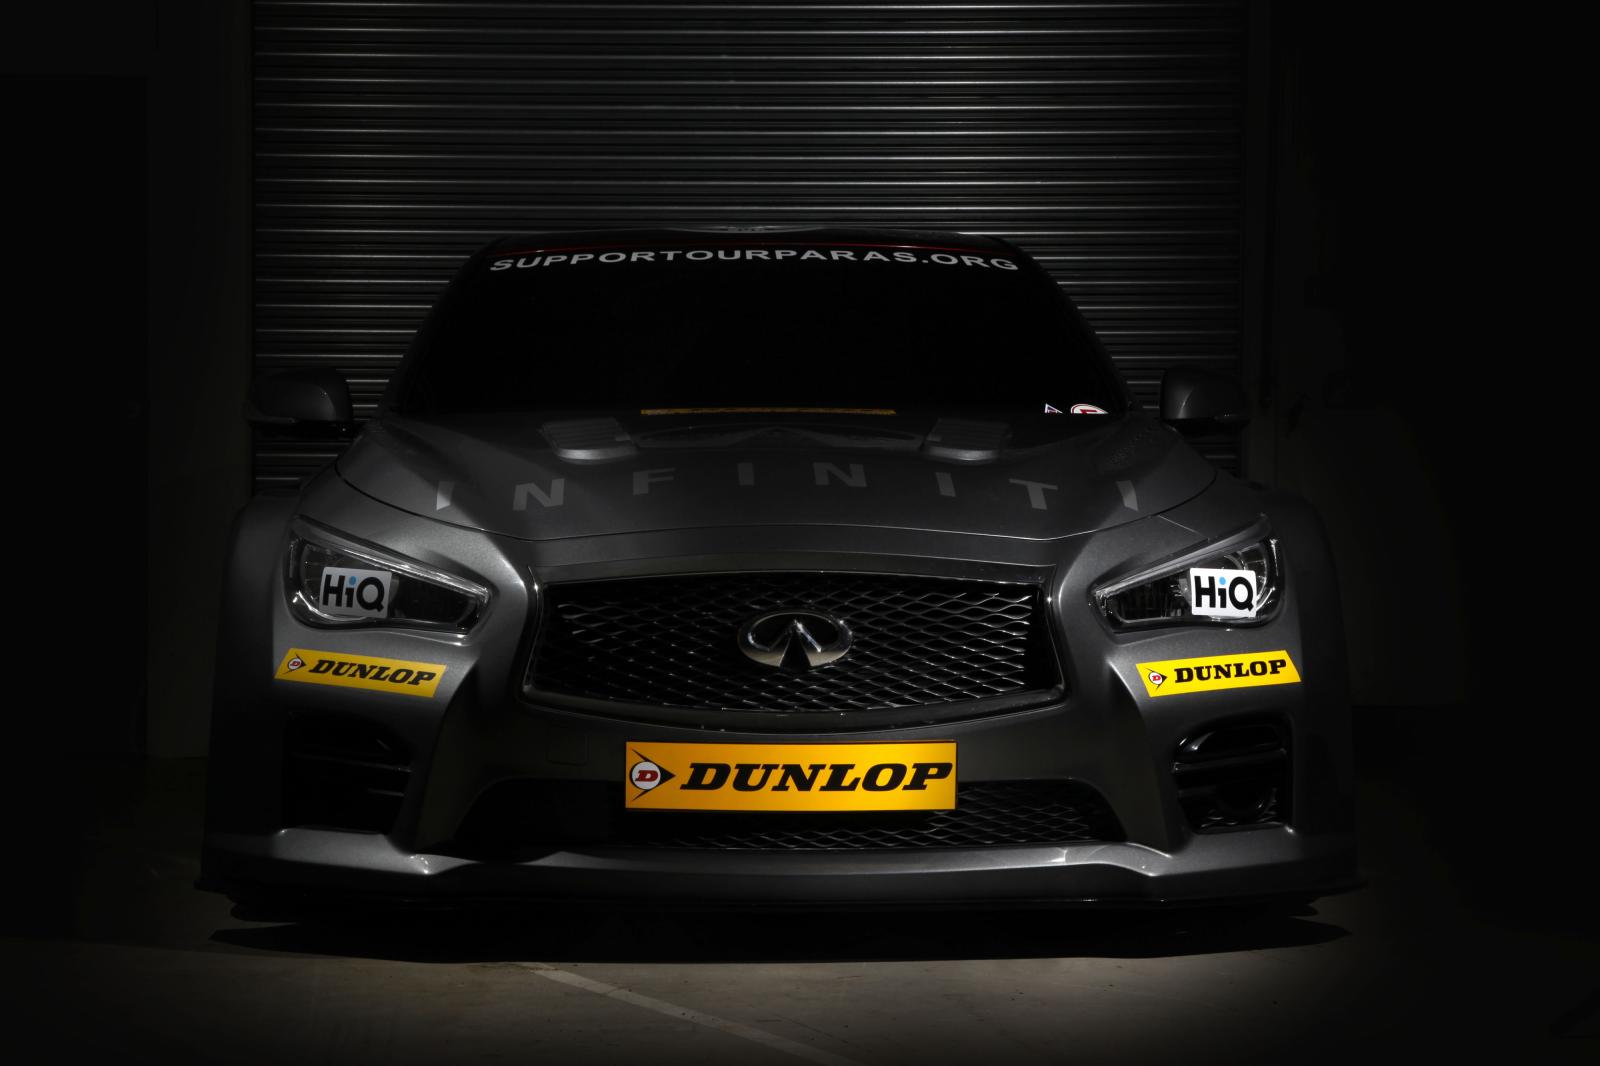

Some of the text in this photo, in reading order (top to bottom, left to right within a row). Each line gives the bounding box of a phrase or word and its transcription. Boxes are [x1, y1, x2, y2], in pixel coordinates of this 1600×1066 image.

[489, 249, 1019, 271] SUPPORTOURPARAS.ORG
[436, 461, 1138, 511] INFINITI
[322, 574, 384, 612] HiQ
[1194, 575, 1254, 612] HiQ
[309, 660, 436, 686] DUNLOP
[1174, 659, 1287, 683] DUNLOP
[635, 762, 953, 792] D DUNLOP
